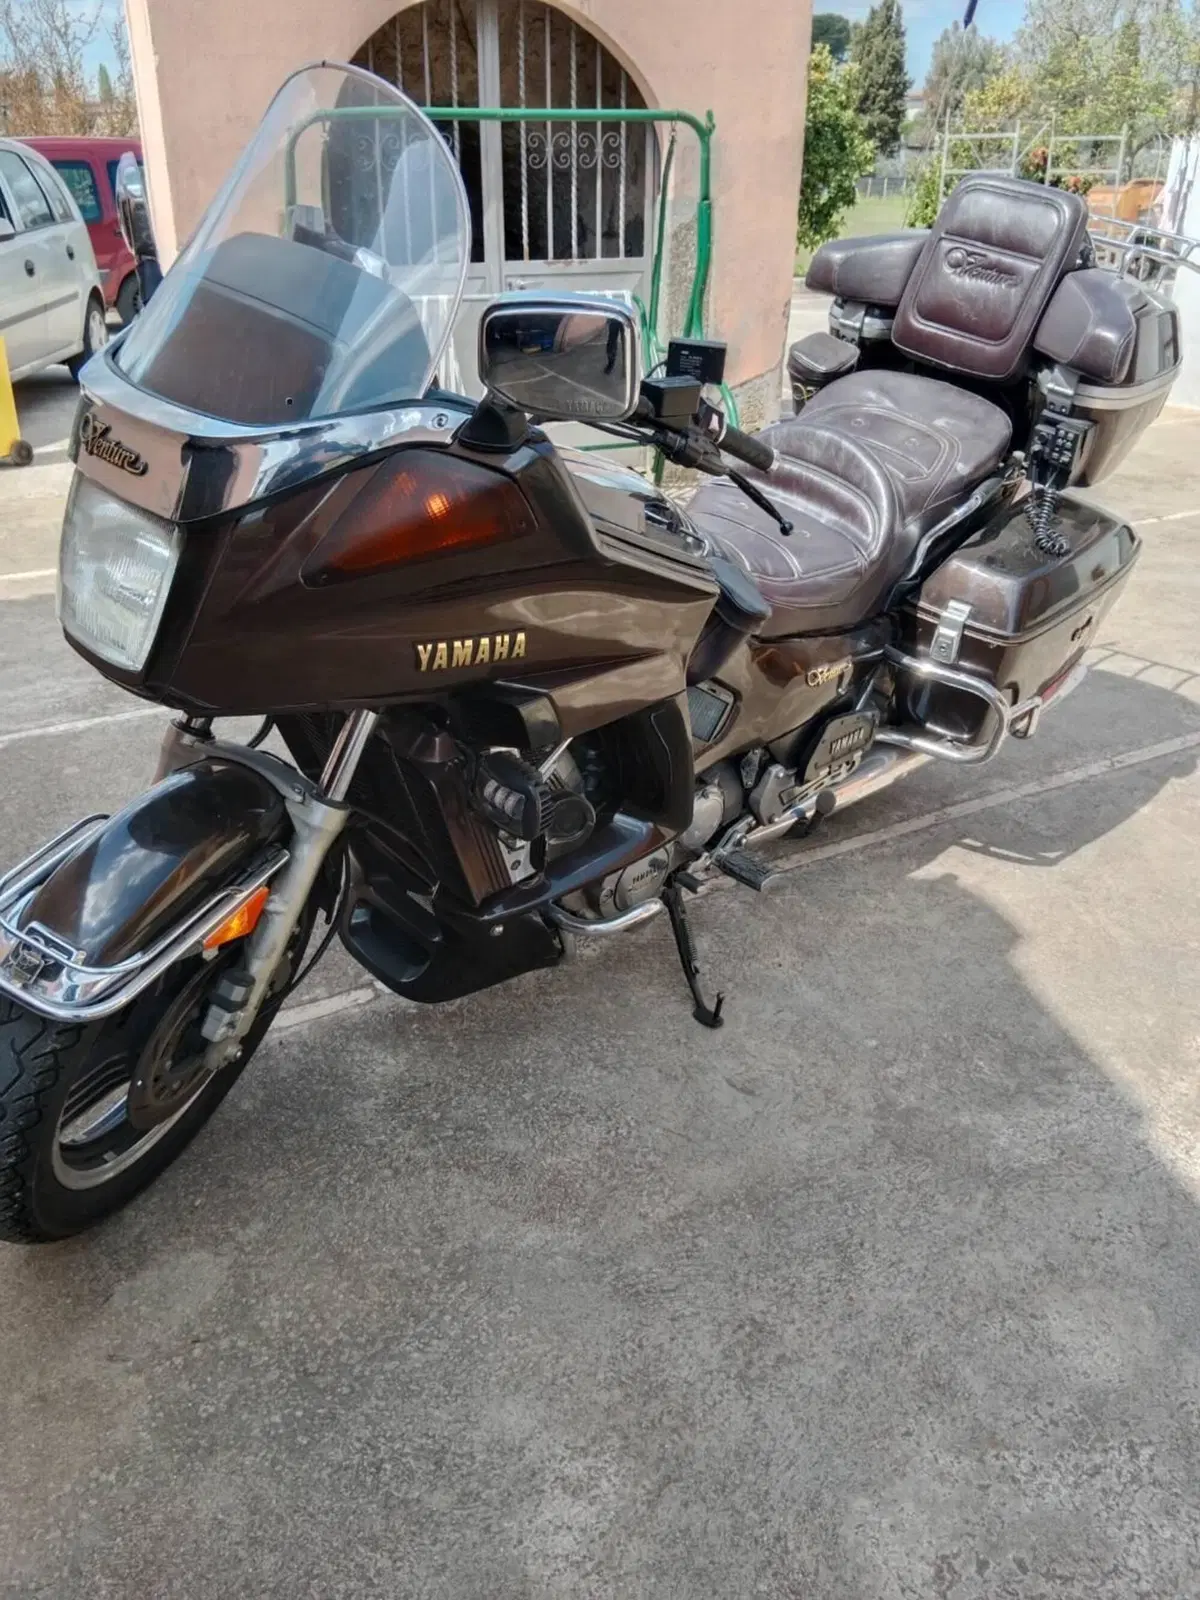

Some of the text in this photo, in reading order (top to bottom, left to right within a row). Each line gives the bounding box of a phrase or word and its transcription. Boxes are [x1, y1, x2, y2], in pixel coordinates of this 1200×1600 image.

[84, 419, 149, 476] Venture
[416, 631, 527, 672] YAMAHA
[831, 727, 864, 755] YAMAHA
